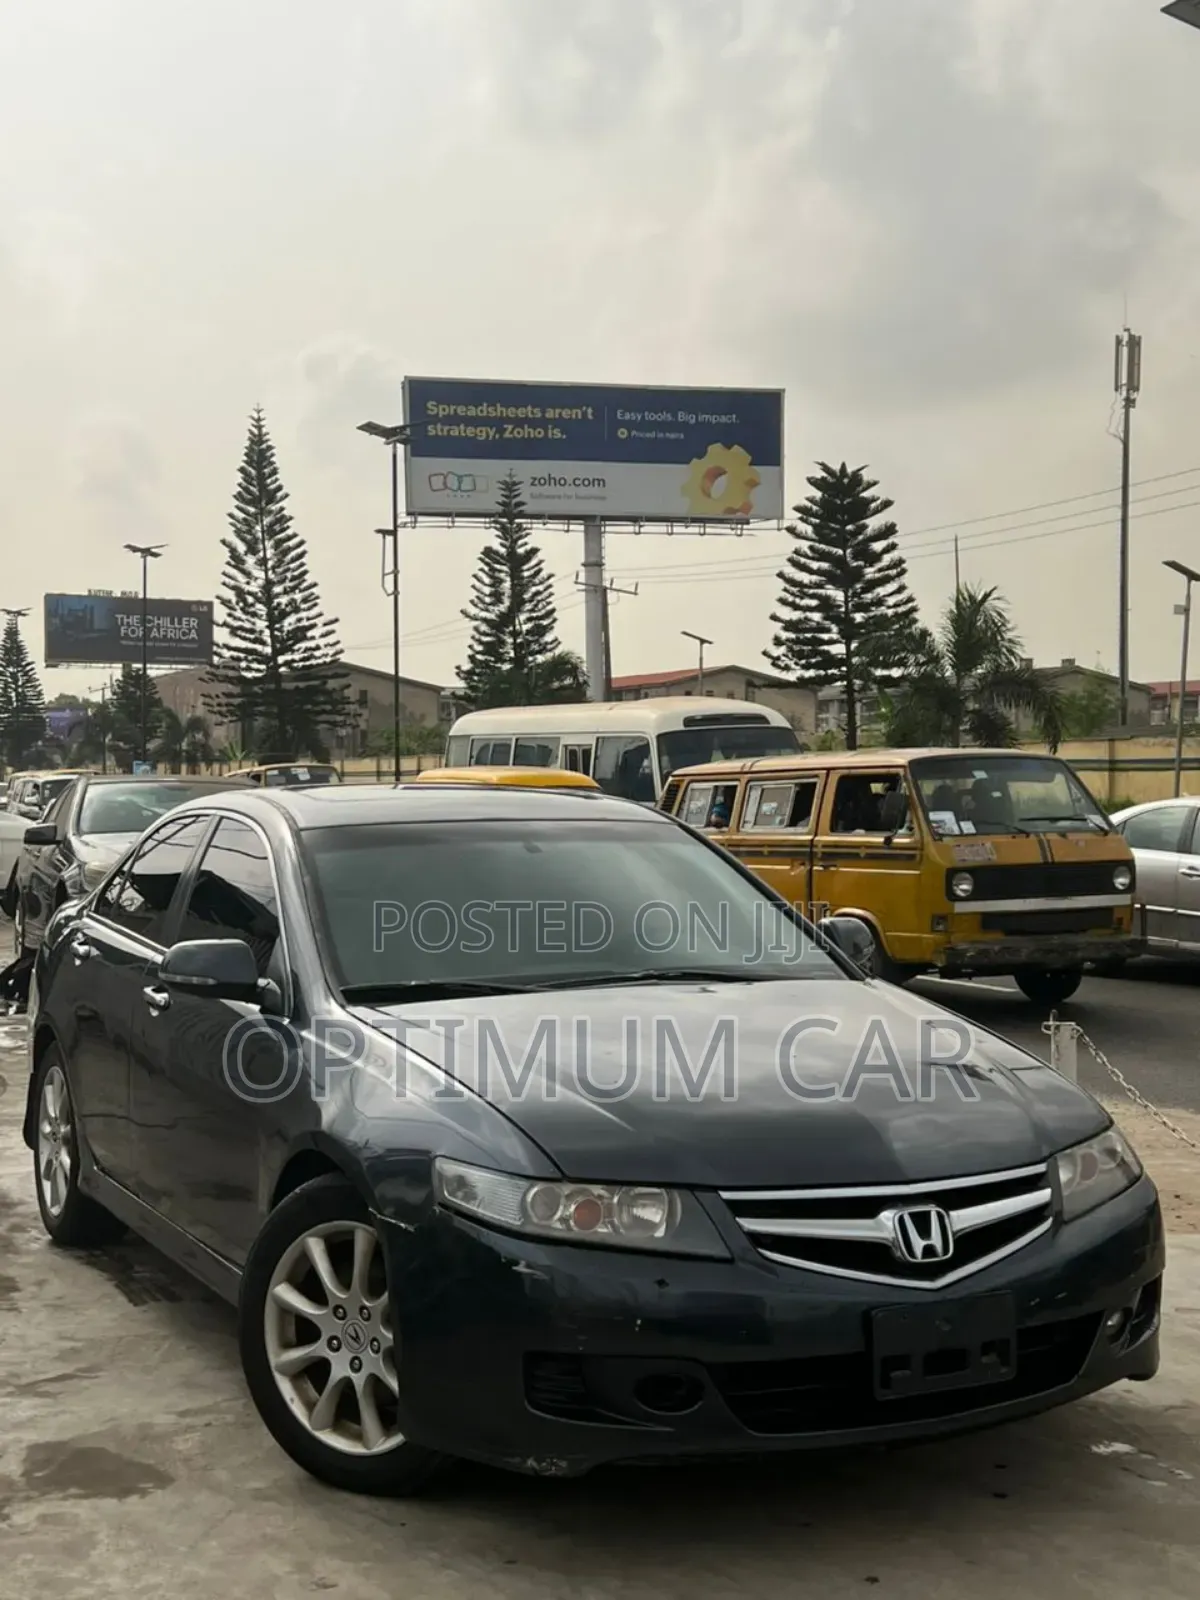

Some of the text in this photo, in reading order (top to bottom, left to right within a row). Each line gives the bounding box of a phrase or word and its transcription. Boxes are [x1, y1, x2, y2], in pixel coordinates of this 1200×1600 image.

[426, 401, 594, 420] Spreadsheets aren't
[616, 409, 740, 424] Easy tools. Big impact.
[427, 423, 567, 440] strategy, Zoho is.
[529, 473, 606, 488] zoho.com
[114, 614, 198, 628] THE CHILLER
[150, 628, 198, 640] AFRICA
